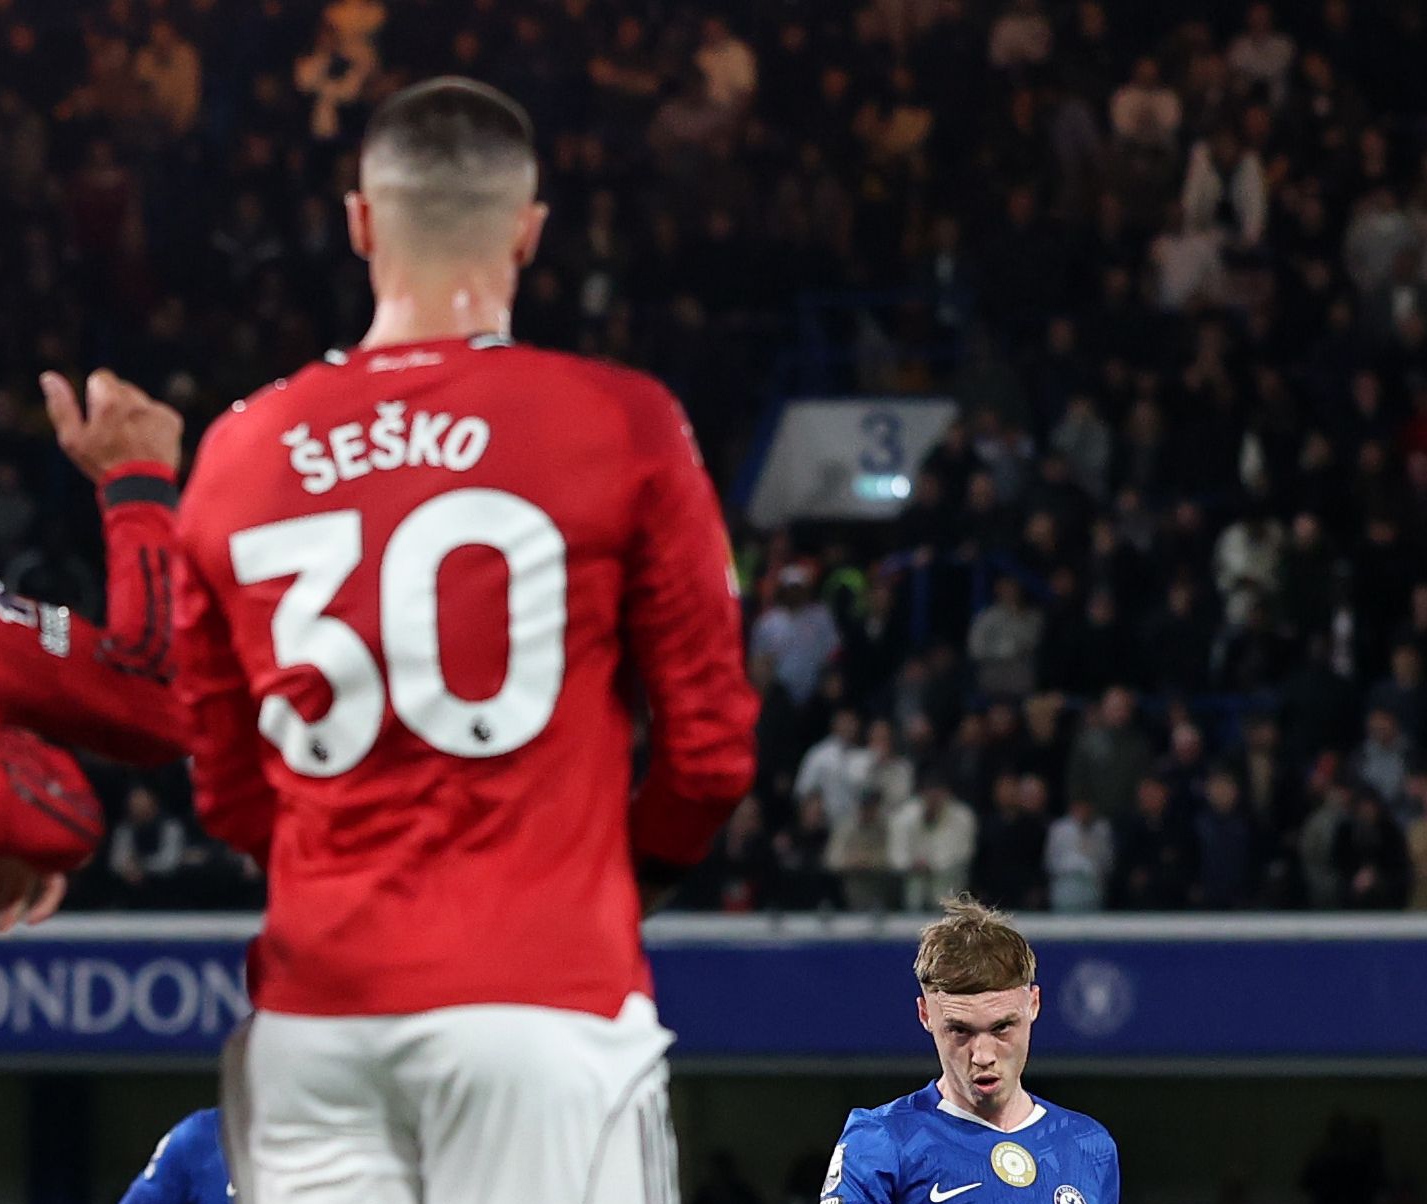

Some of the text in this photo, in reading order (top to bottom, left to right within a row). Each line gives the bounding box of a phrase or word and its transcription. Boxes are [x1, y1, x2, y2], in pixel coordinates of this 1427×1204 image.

[282, 402, 491, 495] ŠEŠKO
[858, 413, 903, 473] 3
[229, 488, 567, 778] 30
